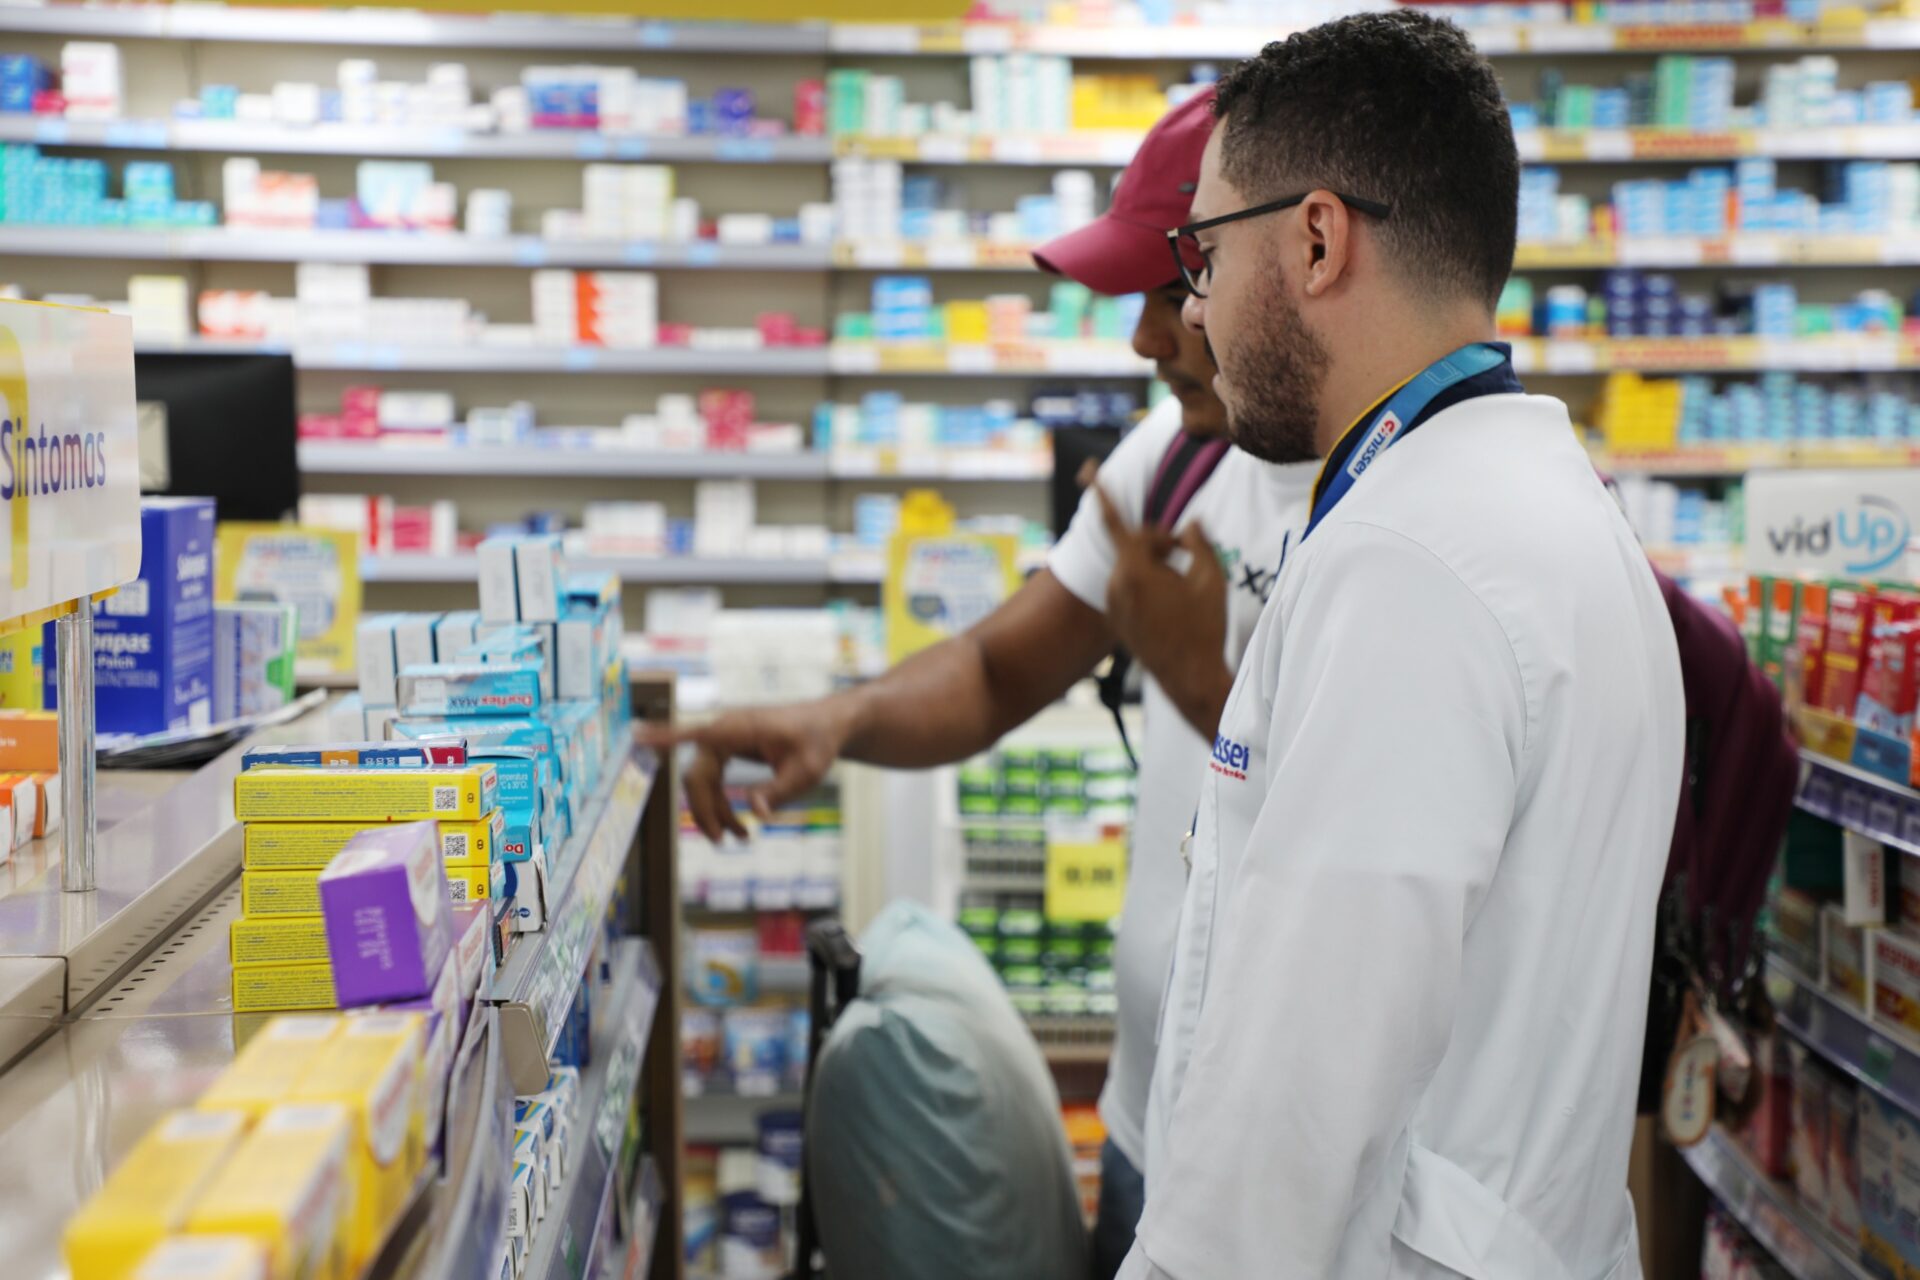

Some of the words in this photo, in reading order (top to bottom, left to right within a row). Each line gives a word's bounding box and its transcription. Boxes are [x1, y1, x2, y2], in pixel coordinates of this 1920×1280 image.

[1, 416, 106, 500] Sintomas
[1353, 432, 1386, 475] nissei
[93, 632, 152, 656] onpas
